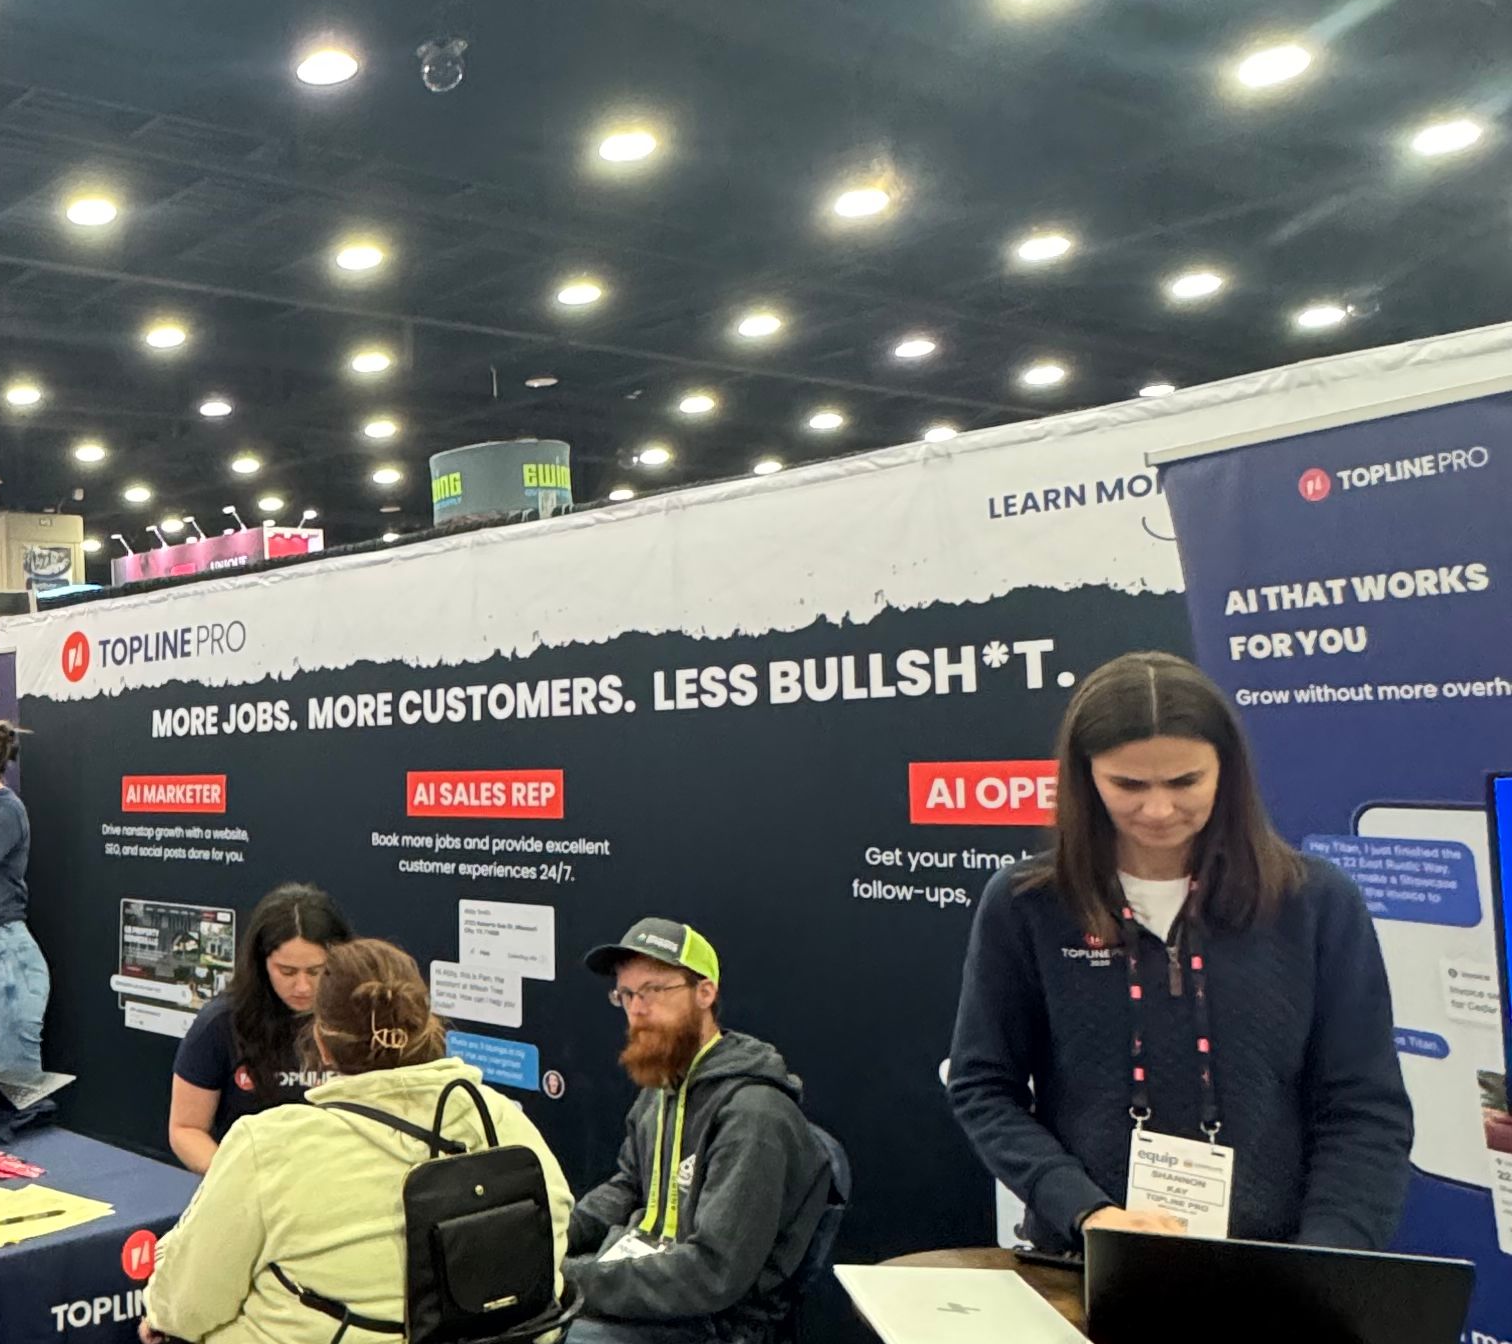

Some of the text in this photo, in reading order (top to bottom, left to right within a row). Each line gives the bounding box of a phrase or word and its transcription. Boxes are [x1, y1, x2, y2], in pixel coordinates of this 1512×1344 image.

[989, 483, 1086, 519] LEARN
[1225, 562, 1490, 616] AI THAT WORKS
[1229, 626, 1367, 661] FOR YOU
[152, 704, 219, 738] MORE
[222, 700, 298, 735] JOBS.
[308, 692, 393, 730] MORE
[399, 674, 636, 725] CUSTOMERS.
[653, 663, 758, 711] LESS
[1236, 676, 1512, 706] Grow without more overh
[126, 783, 222, 804] AI MARKETER
[414, 781, 556, 807] AI SALES REP
[925, 777, 966, 809] AI
[102, 823, 121, 836] Drive
[122, 825, 154, 839] nonstop
[155, 825, 184, 841] growth
[185, 826, 204, 839] with
[371, 832, 611, 856] Book more jobs and provide excellent
[122, 844, 138, 856] and
[139, 844, 162, 858] social
[163, 846, 186, 861] posts
[188, 847, 210, 861] done
[211, 848, 224, 861] for
[865, 847, 903, 866] Get
[908, 850, 957, 873] your
[962, 848, 1015, 870] time
[1309, 841, 1330, 854] Hey
[1394, 844, 1439, 858] finished
[1441, 846, 1462, 860] the
[399, 858, 575, 884] customer experiences 24/7.
[852, 878, 972, 908] follow-ups,
[1061, 947, 1111, 959] TOPLINE
[1137, 1149, 1179, 1167] equip
[1146, 1192, 1185, 1207] TOPLINE
